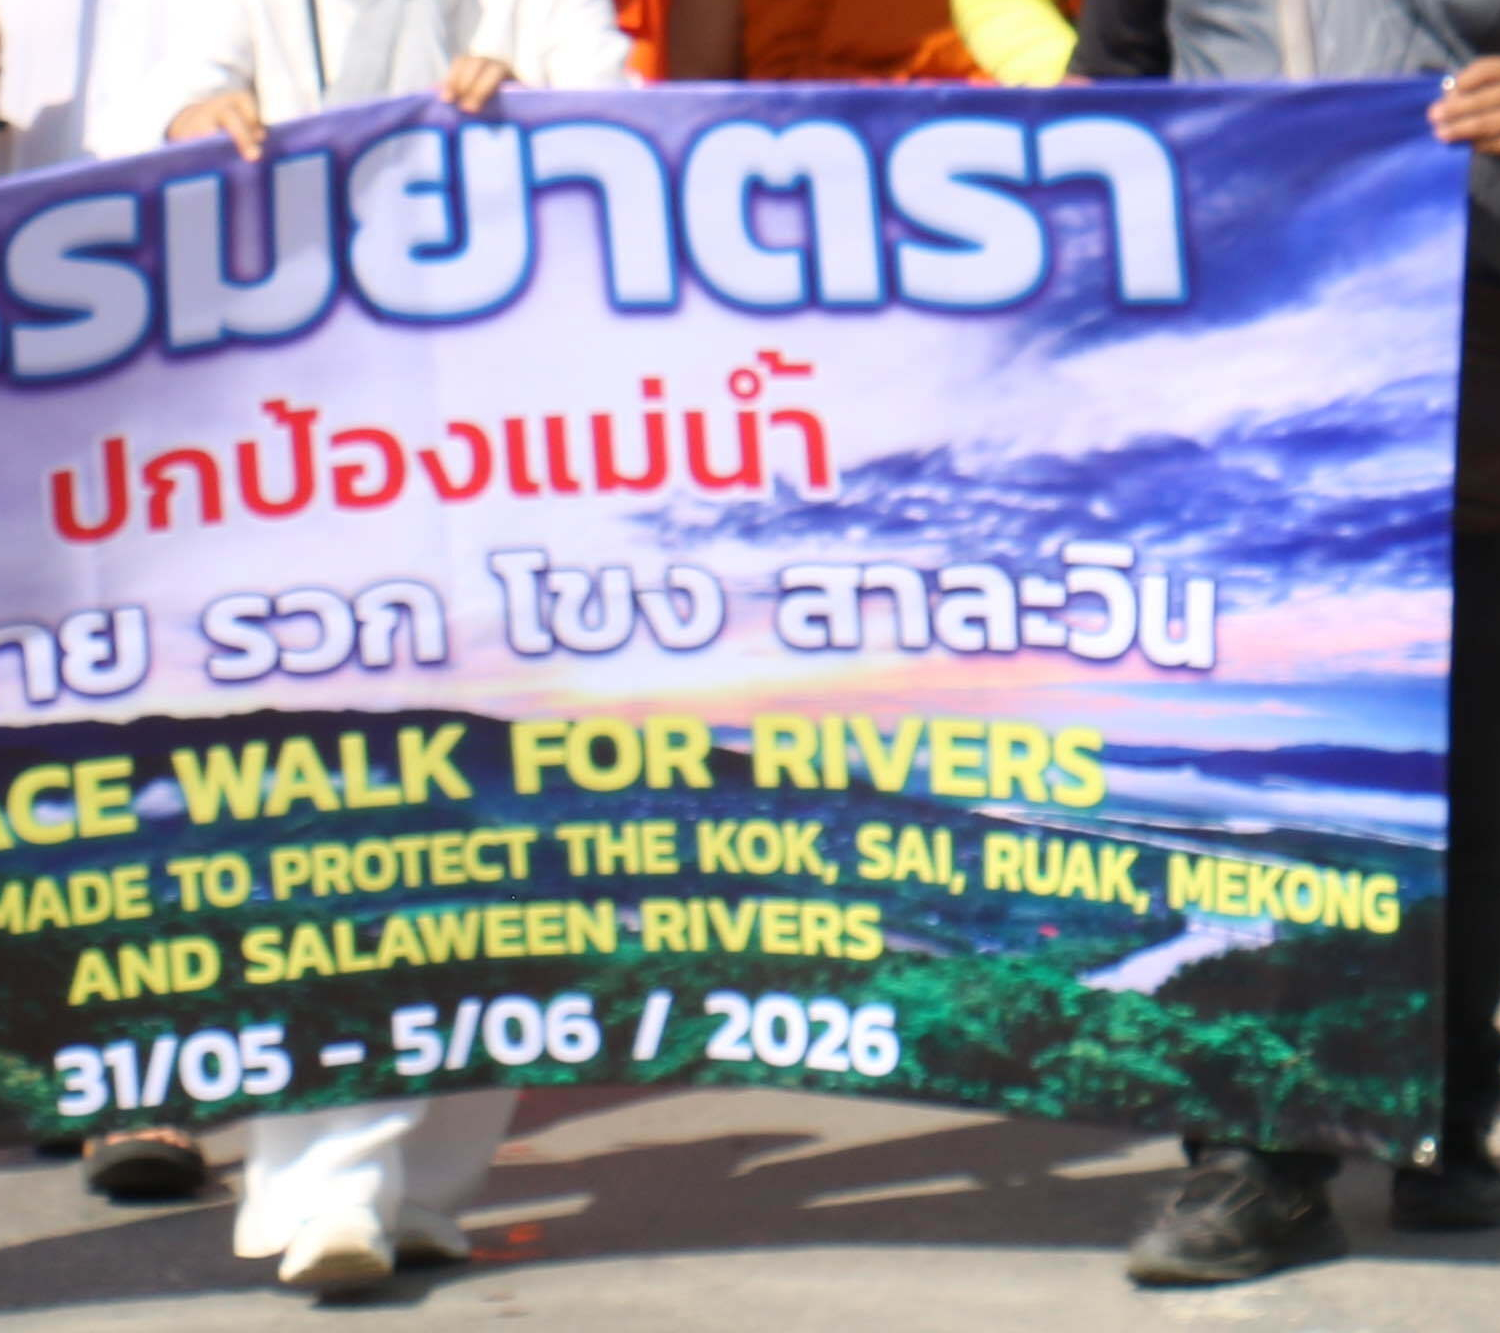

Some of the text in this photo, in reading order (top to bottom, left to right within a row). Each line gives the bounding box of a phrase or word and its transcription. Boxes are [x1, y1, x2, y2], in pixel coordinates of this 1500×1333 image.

[49, 349, 831, 545] ปกป้องแม่น้ำ
[201, 580, 449, 682] รวก
[489, 546, 727, 655] โขง
[774, 541, 1217, 669] สาละวิน
[171, 725, 472, 826] WALK
[512, 713, 714, 795] FOR
[751, 716, 1108, 807] RIVERS
[165, 853, 252, 912] TO
[271, 826, 538, 900] PROTECT
[555, 818, 678, 878] THE
[697, 820, 842, 886] KOK,
[854, 826, 969, 896] SAI,
[983, 838, 1150, 917] RUAK,
[1166, 851, 1403, 935] MEKONG
[66, 896, 885, 1006] AND SALAWEEN RIVERS
[52, 1021, 293, 1119] 31/05
[388, 992, 601, 1079] 5/06
[631, 989, 674, 1063] /
[702, 992, 901, 1078] 2026
